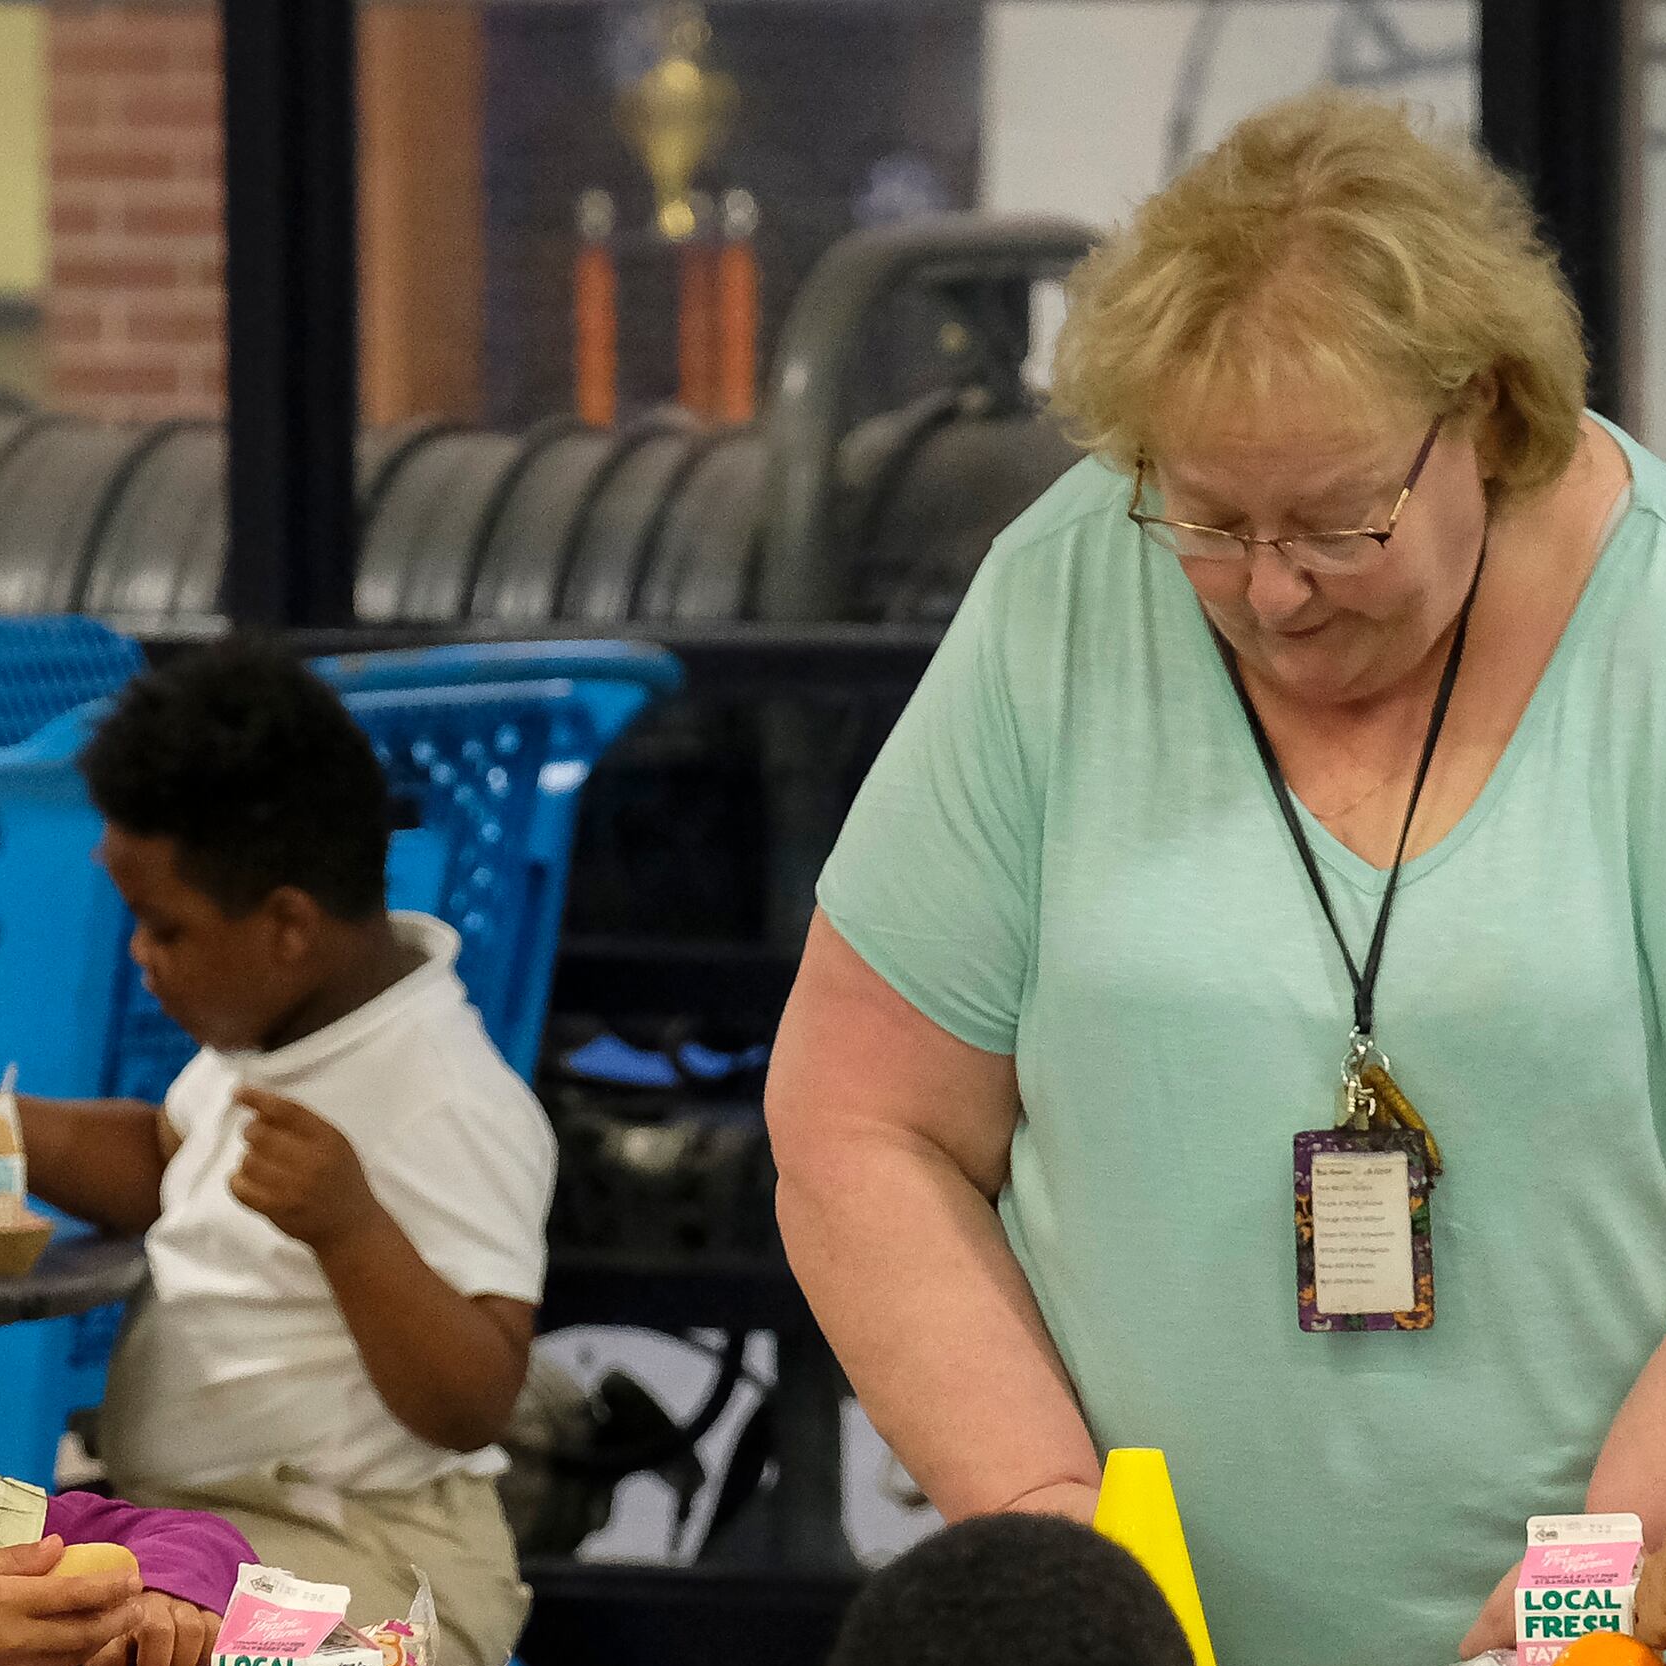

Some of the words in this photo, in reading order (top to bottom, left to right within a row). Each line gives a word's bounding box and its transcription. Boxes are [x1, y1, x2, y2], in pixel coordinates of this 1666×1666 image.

[1525, 1589, 1622, 1610] LOCAL
[1525, 1615, 1620, 1638] FRESH
[1526, 1647, 1563, 1663] FAT
